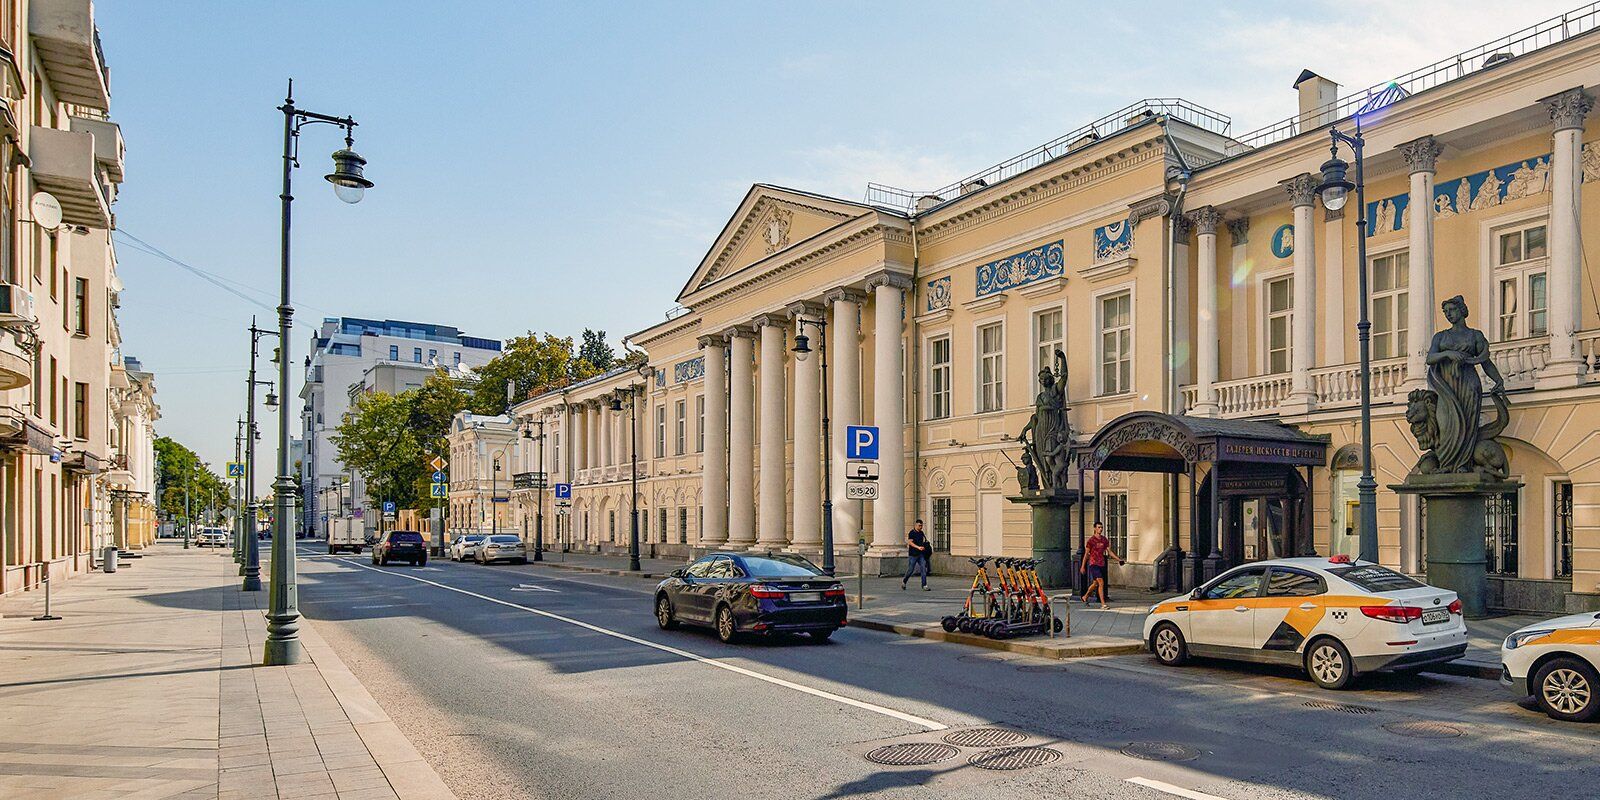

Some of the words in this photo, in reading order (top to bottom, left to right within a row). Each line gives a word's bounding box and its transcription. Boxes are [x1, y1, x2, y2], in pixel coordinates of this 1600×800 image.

[856, 430, 874, 456] P
[1226, 444, 1254, 454] ГАЛЕРЕЯ
[1256, 446, 1290, 457] ИСКУССТВ
[560, 485, 568, 496] P
[386, 502, 394, 510] P
